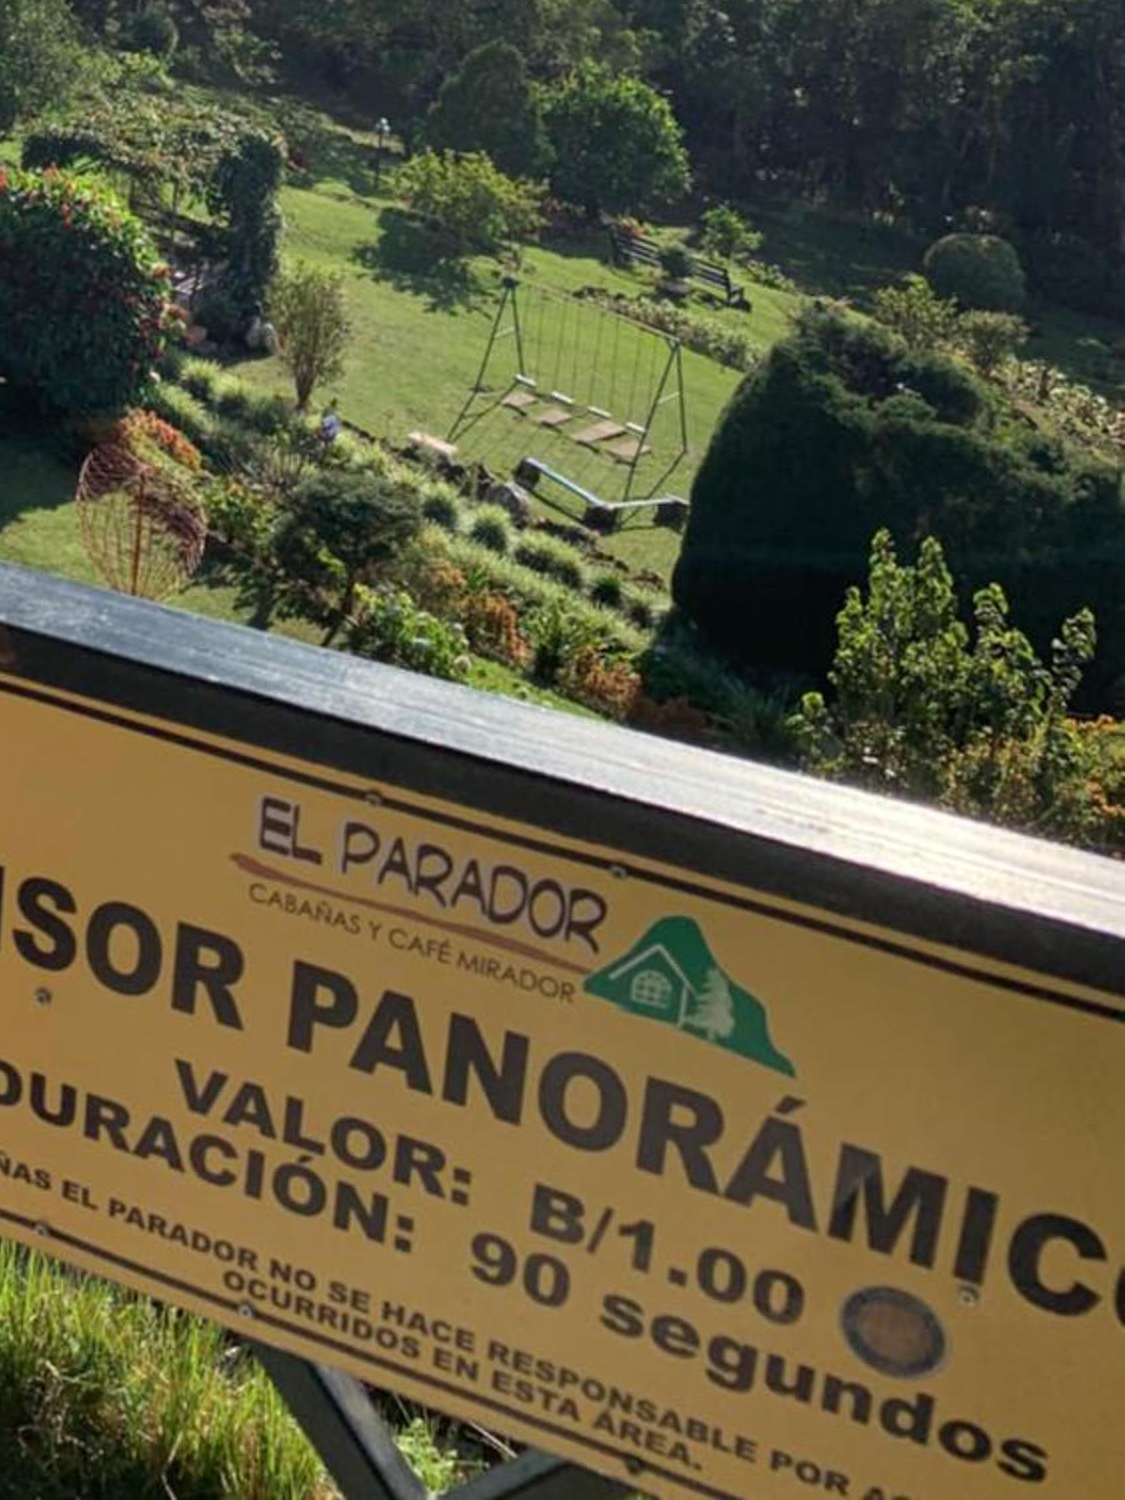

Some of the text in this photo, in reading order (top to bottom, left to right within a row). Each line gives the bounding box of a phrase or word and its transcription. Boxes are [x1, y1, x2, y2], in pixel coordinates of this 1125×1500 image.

[249, 883, 576, 1003] CABAÑAS Y CAFÉ MIRADOR
[260, 796, 608, 953] EL PARADOR
[175, 1057, 806, 1328] VALOR: B/1.00
[286, 959, 1125, 1328] PANORÁMIC
[62, 1179, 98, 1211] EL
[107, 1198, 259, 1272] PARADOR
[269, 1258, 317, 1292] NO
[327, 1280, 372, 1314] SE
[381, 1301, 476, 1352] HACE
[487, 1340, 759, 1463] RESPONSABLE
[769, 1450, 851, 1497] POR
[222, 1270, 422, 1360] OCURRIDOS
[432, 1347, 480, 1382] EN
[491, 1369, 581, 1423] ESTA
[470, 1231, 572, 1308] 90
[599, 1292, 1049, 1484] segundos
